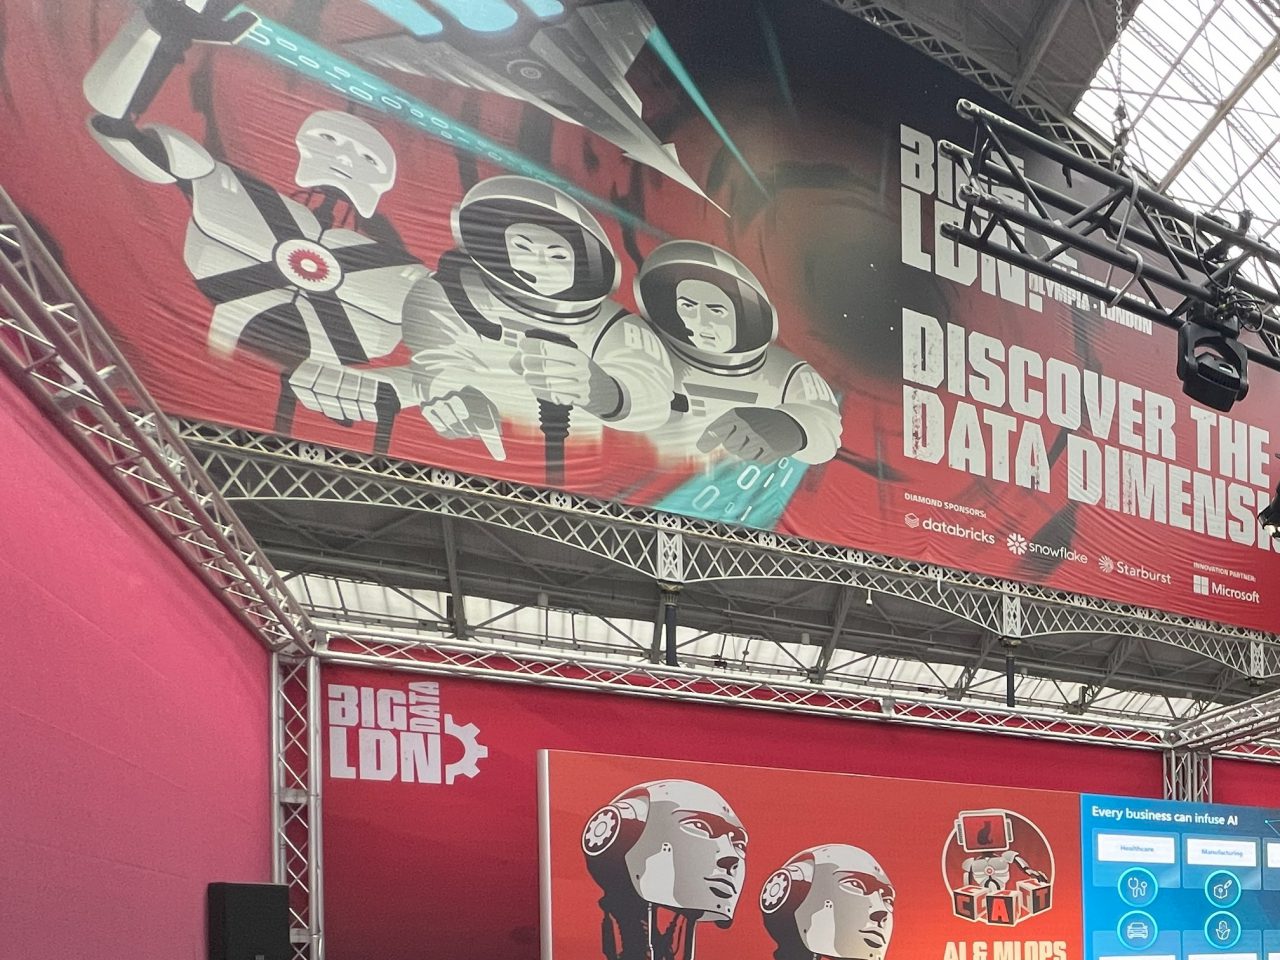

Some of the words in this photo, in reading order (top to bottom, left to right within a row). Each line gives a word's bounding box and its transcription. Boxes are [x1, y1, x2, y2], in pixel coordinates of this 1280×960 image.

[902, 307, 1177, 461] DISCOVER
[902, 384, 1051, 494] DATA
[1190, 405, 1270, 489] THE
[904, 492, 943, 508] DIAMOND
[922, 517, 996, 545] databricks
[1028, 541, 1088, 565] snowflake
[1116, 561, 1172, 585] Starburst
[1193, 562, 1229, 577] INNOVATION
[1211, 581, 1260, 604] Microsoft
[327, 683, 408, 731] BIG
[408, 681, 441, 734] DATA
[329, 726, 442, 785] LDN
[1091, 805, 1124, 821] Every
[1125, 807, 1172, 821] business
[1173, 813, 1193, 824] can
[1194, 812, 1226, 825] infuse
[1226, 815, 1239, 826] AI
[1120, 844, 1155, 853] Healthcare
[1201, 848, 1244, 858] Manufacturing
